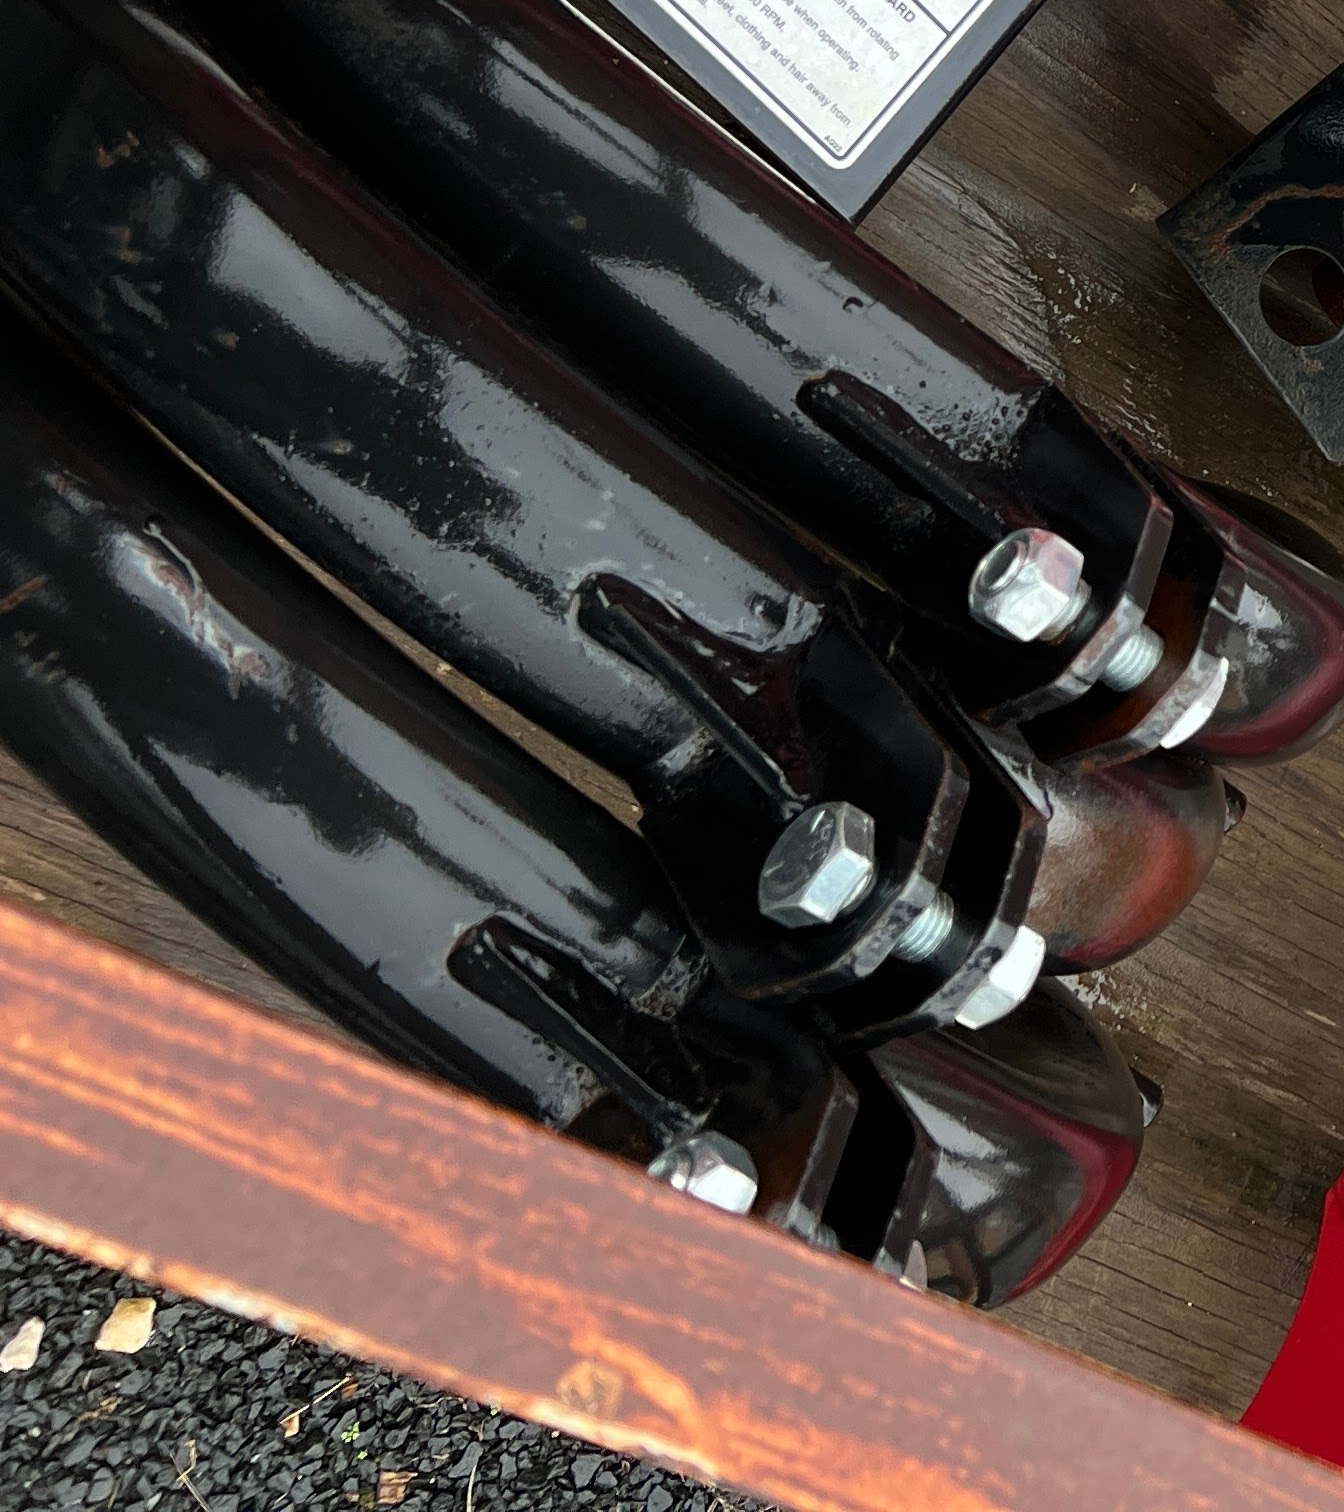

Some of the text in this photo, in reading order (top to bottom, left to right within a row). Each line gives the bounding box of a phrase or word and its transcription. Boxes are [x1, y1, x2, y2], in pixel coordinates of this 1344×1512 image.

[759, 3, 789, 33] RPM.
[791, 2, 820, 31] when
[815, 26, 863, 74] operating.
[845, 4, 869, 29] from
[864, 24, 900, 61] rotating
[732, 11, 773, 52] clothing
[769, 45, 790, 67] and
[786, 62, 809, 84] hair
[803, 80, 831, 109] away
[829, 102, 852, 127] from
